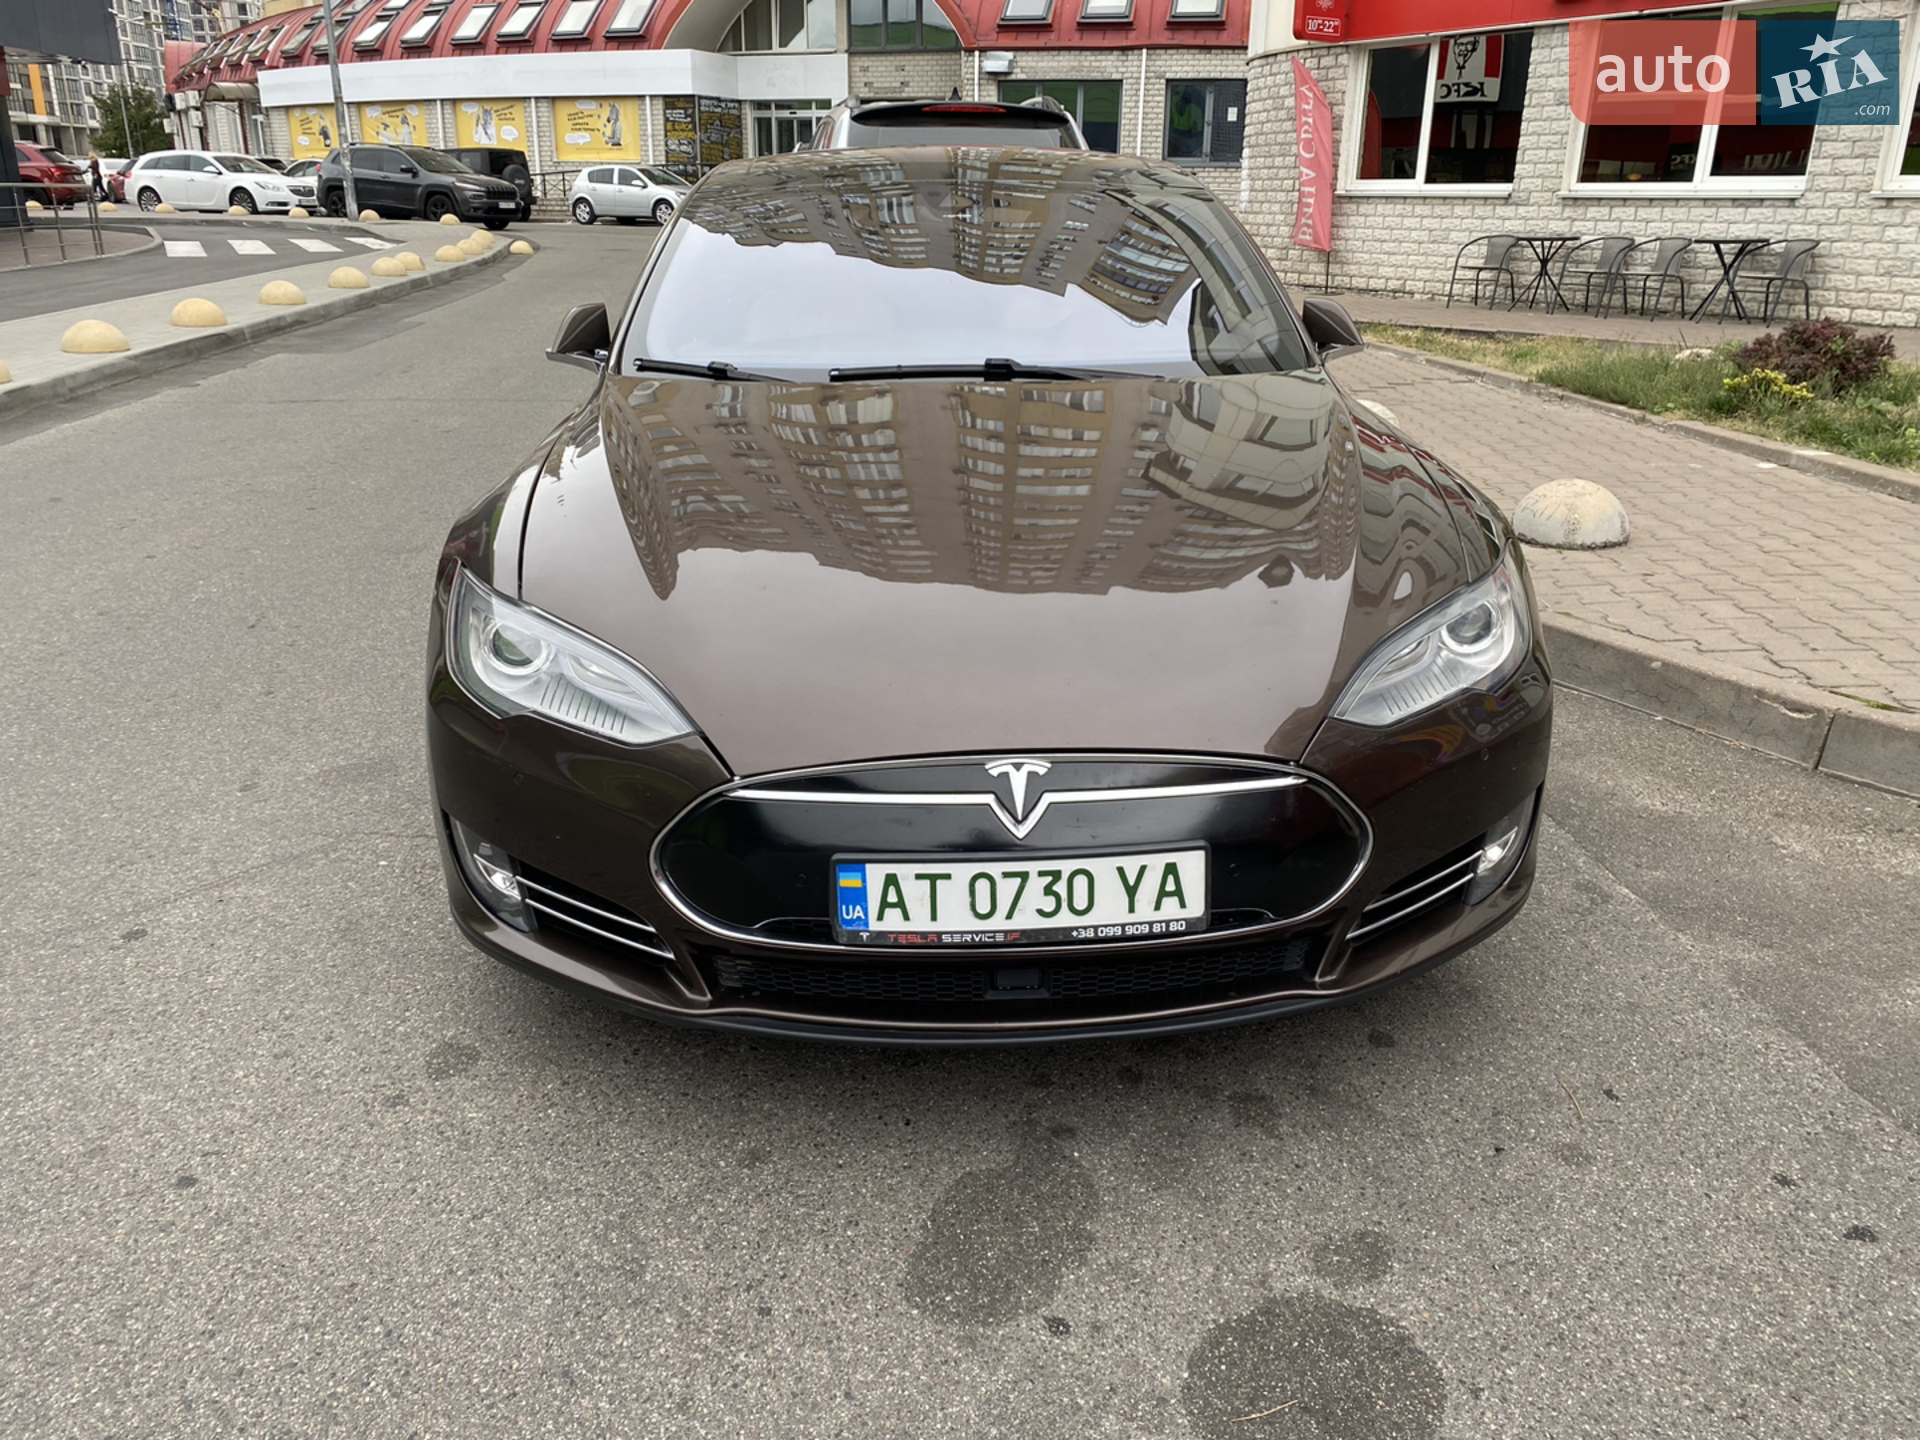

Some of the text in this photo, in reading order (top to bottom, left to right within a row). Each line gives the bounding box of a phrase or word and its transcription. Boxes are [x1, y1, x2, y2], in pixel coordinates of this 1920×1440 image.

[876, 861, 1187, 923] AT 0730 YA
[842, 904, 866, 920] UA
[1071, 920, 1186, 938] +38 099 909 81 80
[887, 933, 938, 944] TESLA
